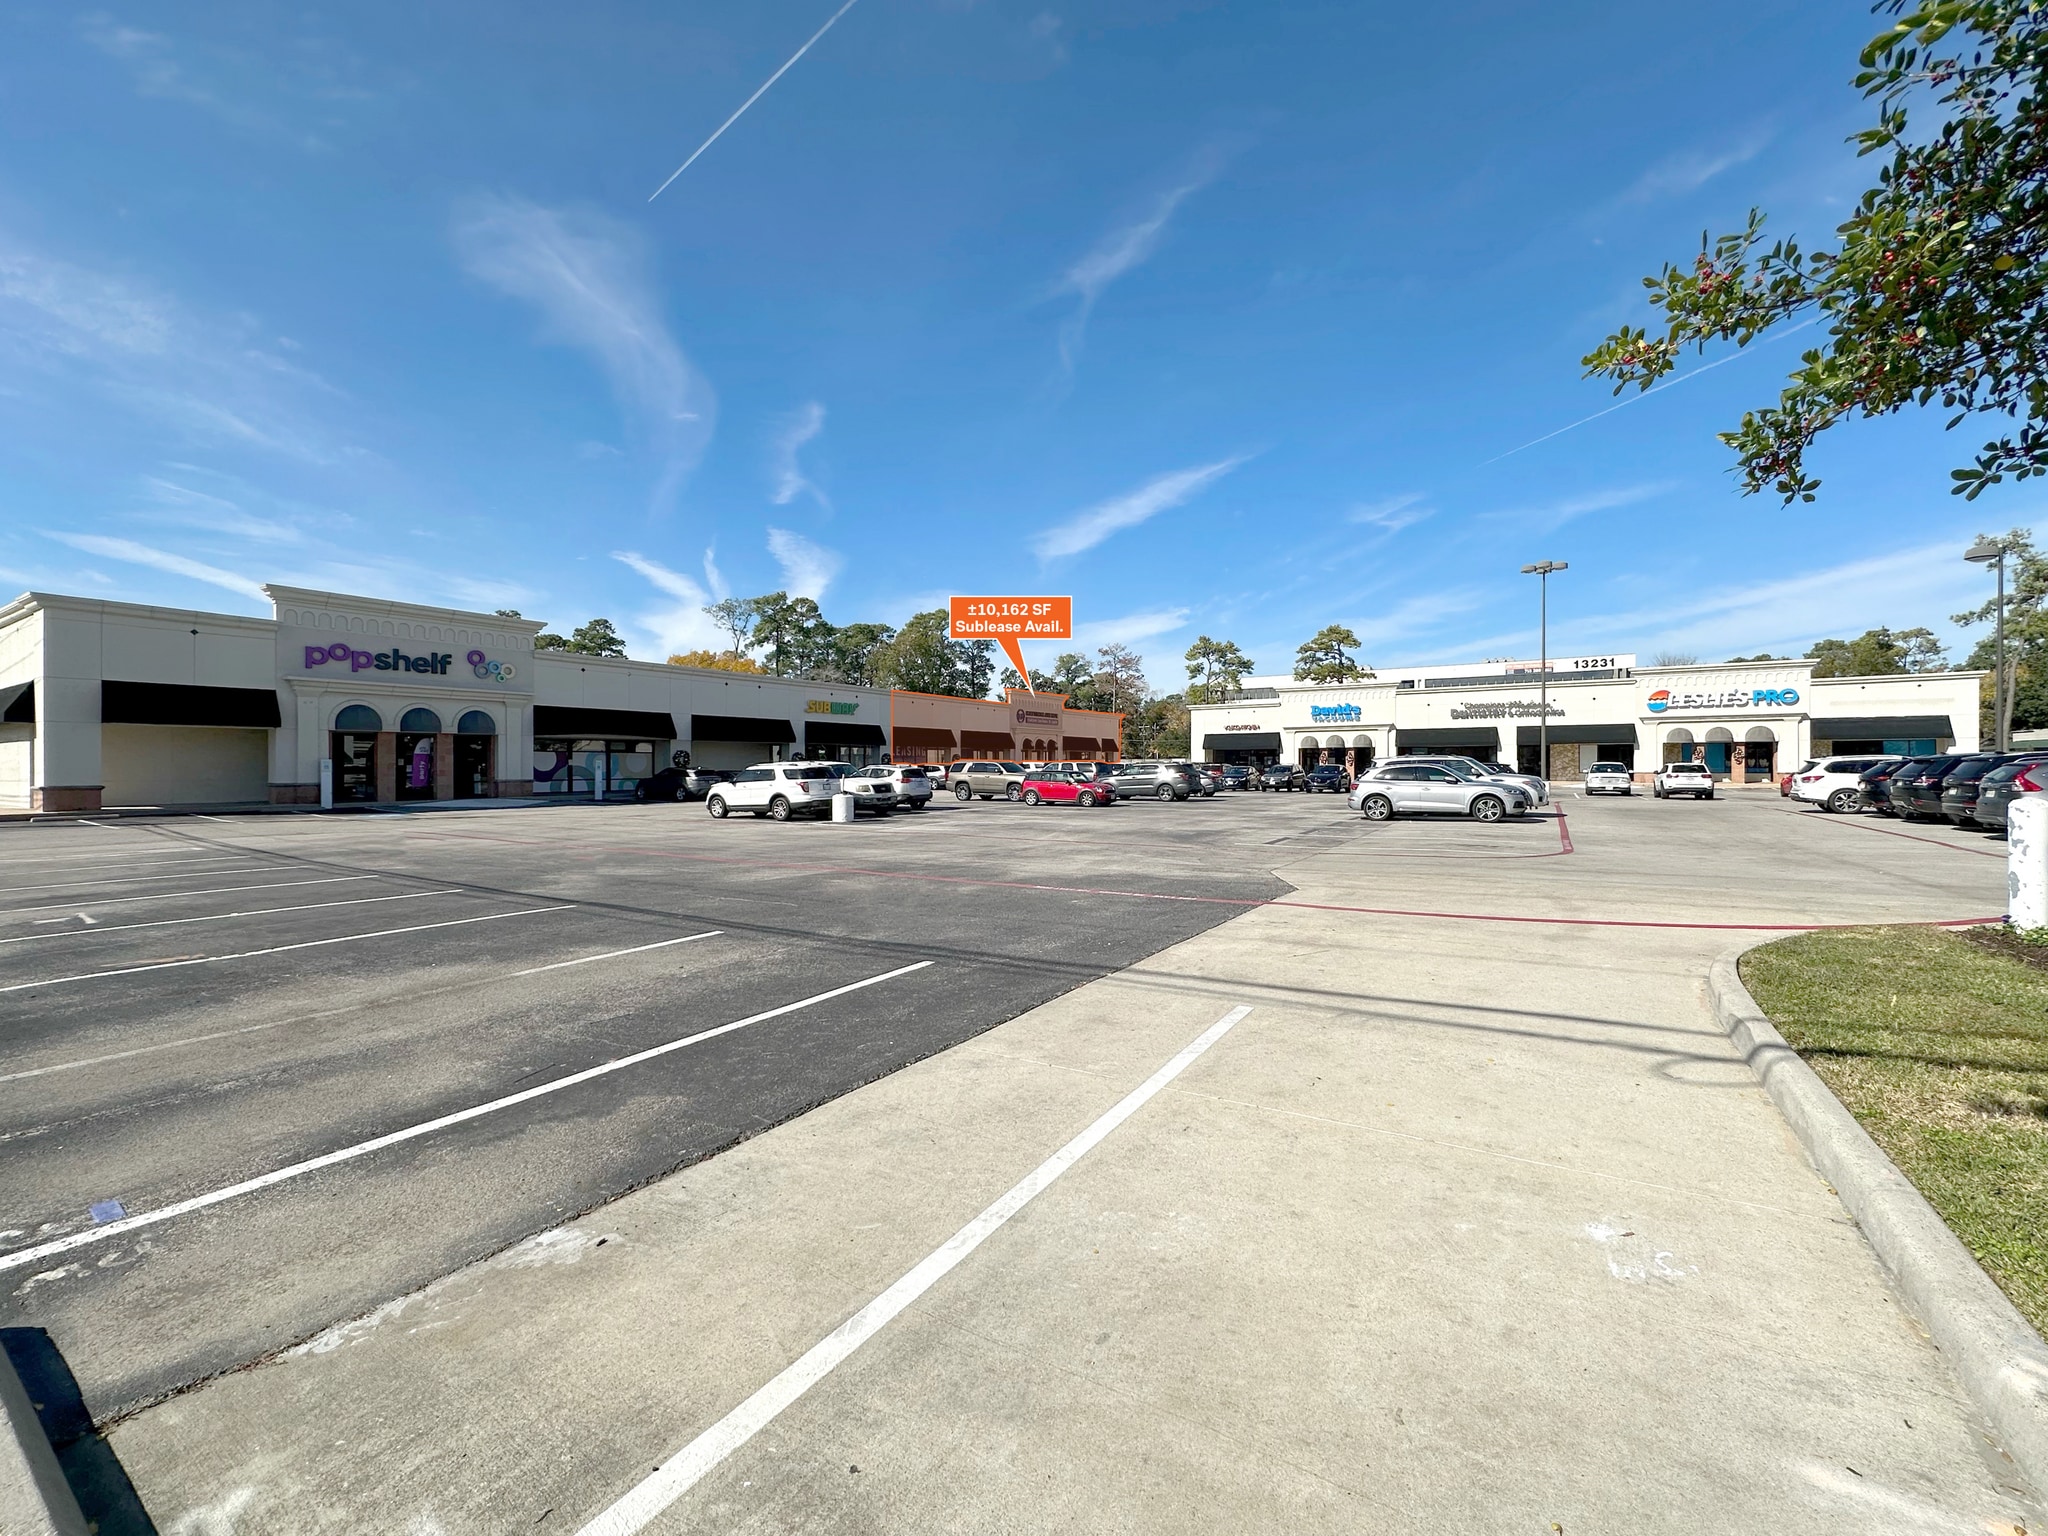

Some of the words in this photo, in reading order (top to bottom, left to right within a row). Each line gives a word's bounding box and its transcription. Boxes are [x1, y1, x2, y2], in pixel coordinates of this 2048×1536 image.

[305, 642, 452, 675] popshelf
[1574, 658, 1615, 669] 13231
[1667, 689, 1752, 709] LESLIE'S
[1752, 688, 1799, 707] PRO
[805, 700, 859, 715] SUBWAY
[893, 745, 926, 757] EASING
